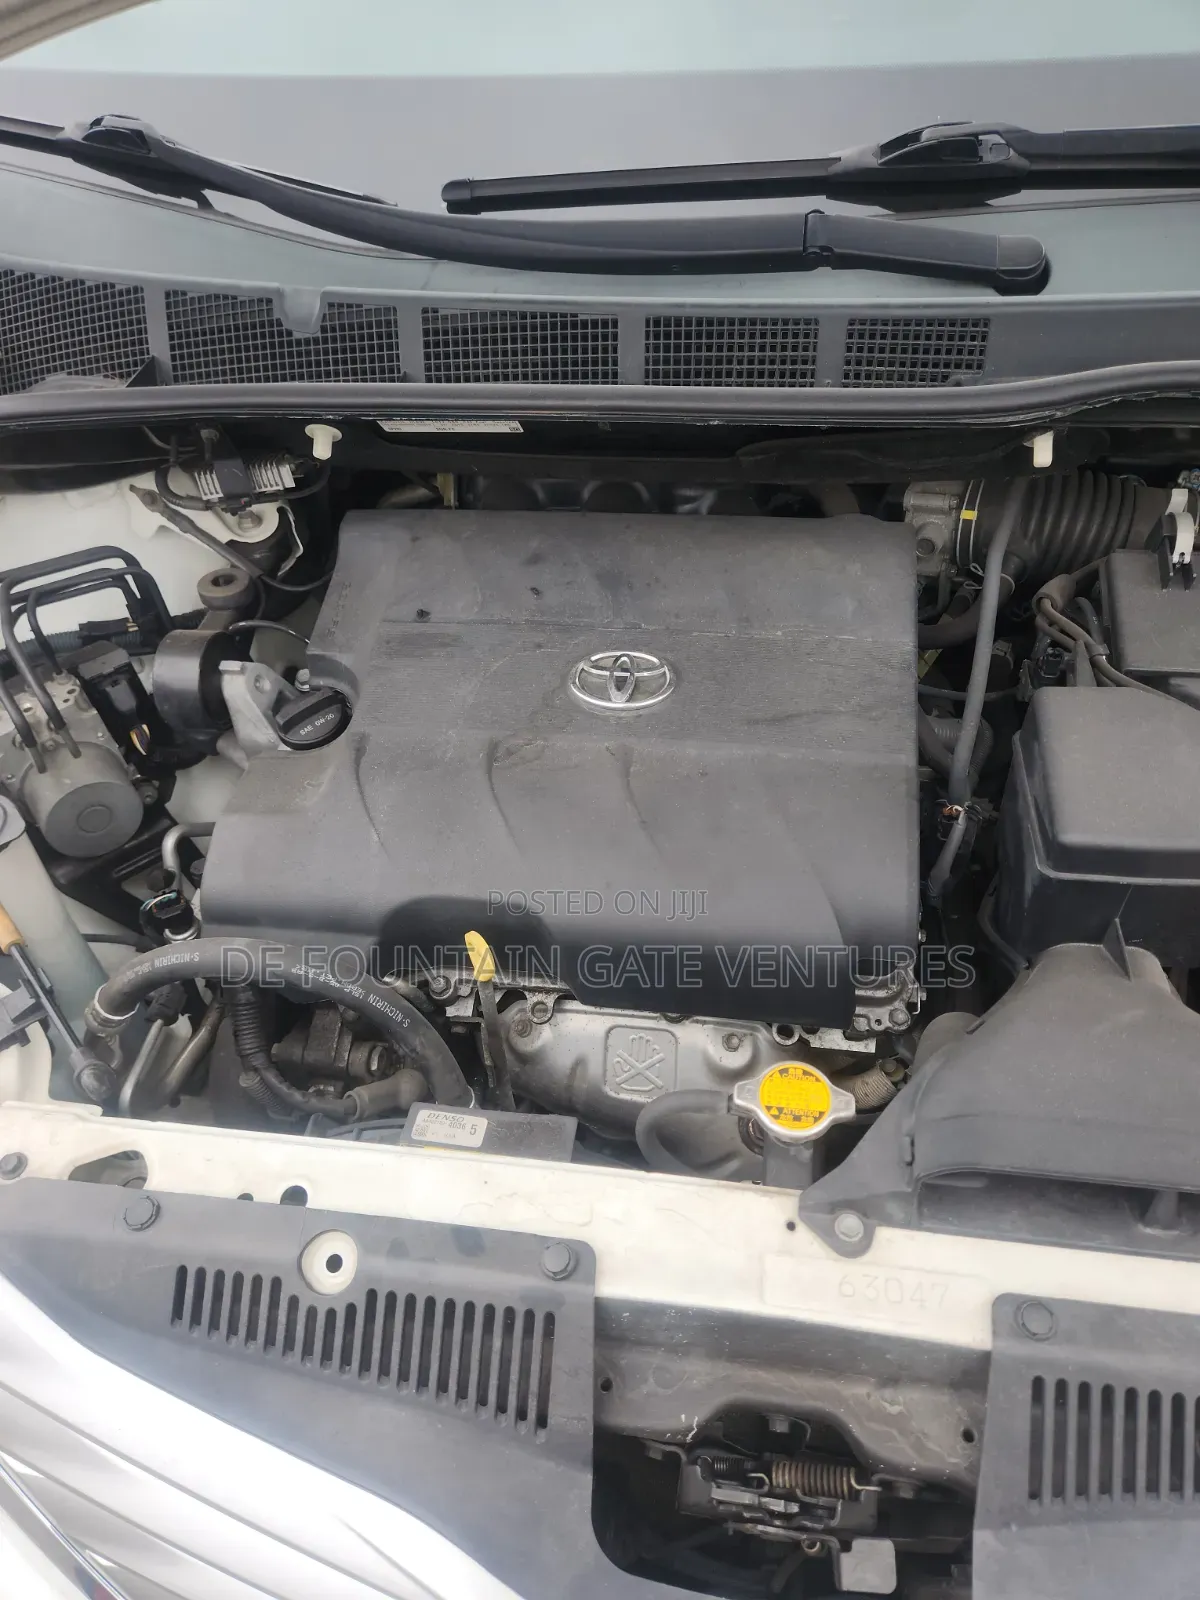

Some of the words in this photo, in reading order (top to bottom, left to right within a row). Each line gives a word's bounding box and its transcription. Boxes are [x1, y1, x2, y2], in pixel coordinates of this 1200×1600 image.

[299, 724, 314, 736] SAE
[314, 713, 335, 727] 0W-20
[427, 1112, 465, 1123] DENSO
[782, 1108, 820, 1118] ATTENTION
[468, 1123, 478, 1136] 5
[838, 1274, 949, 1311] 63047
